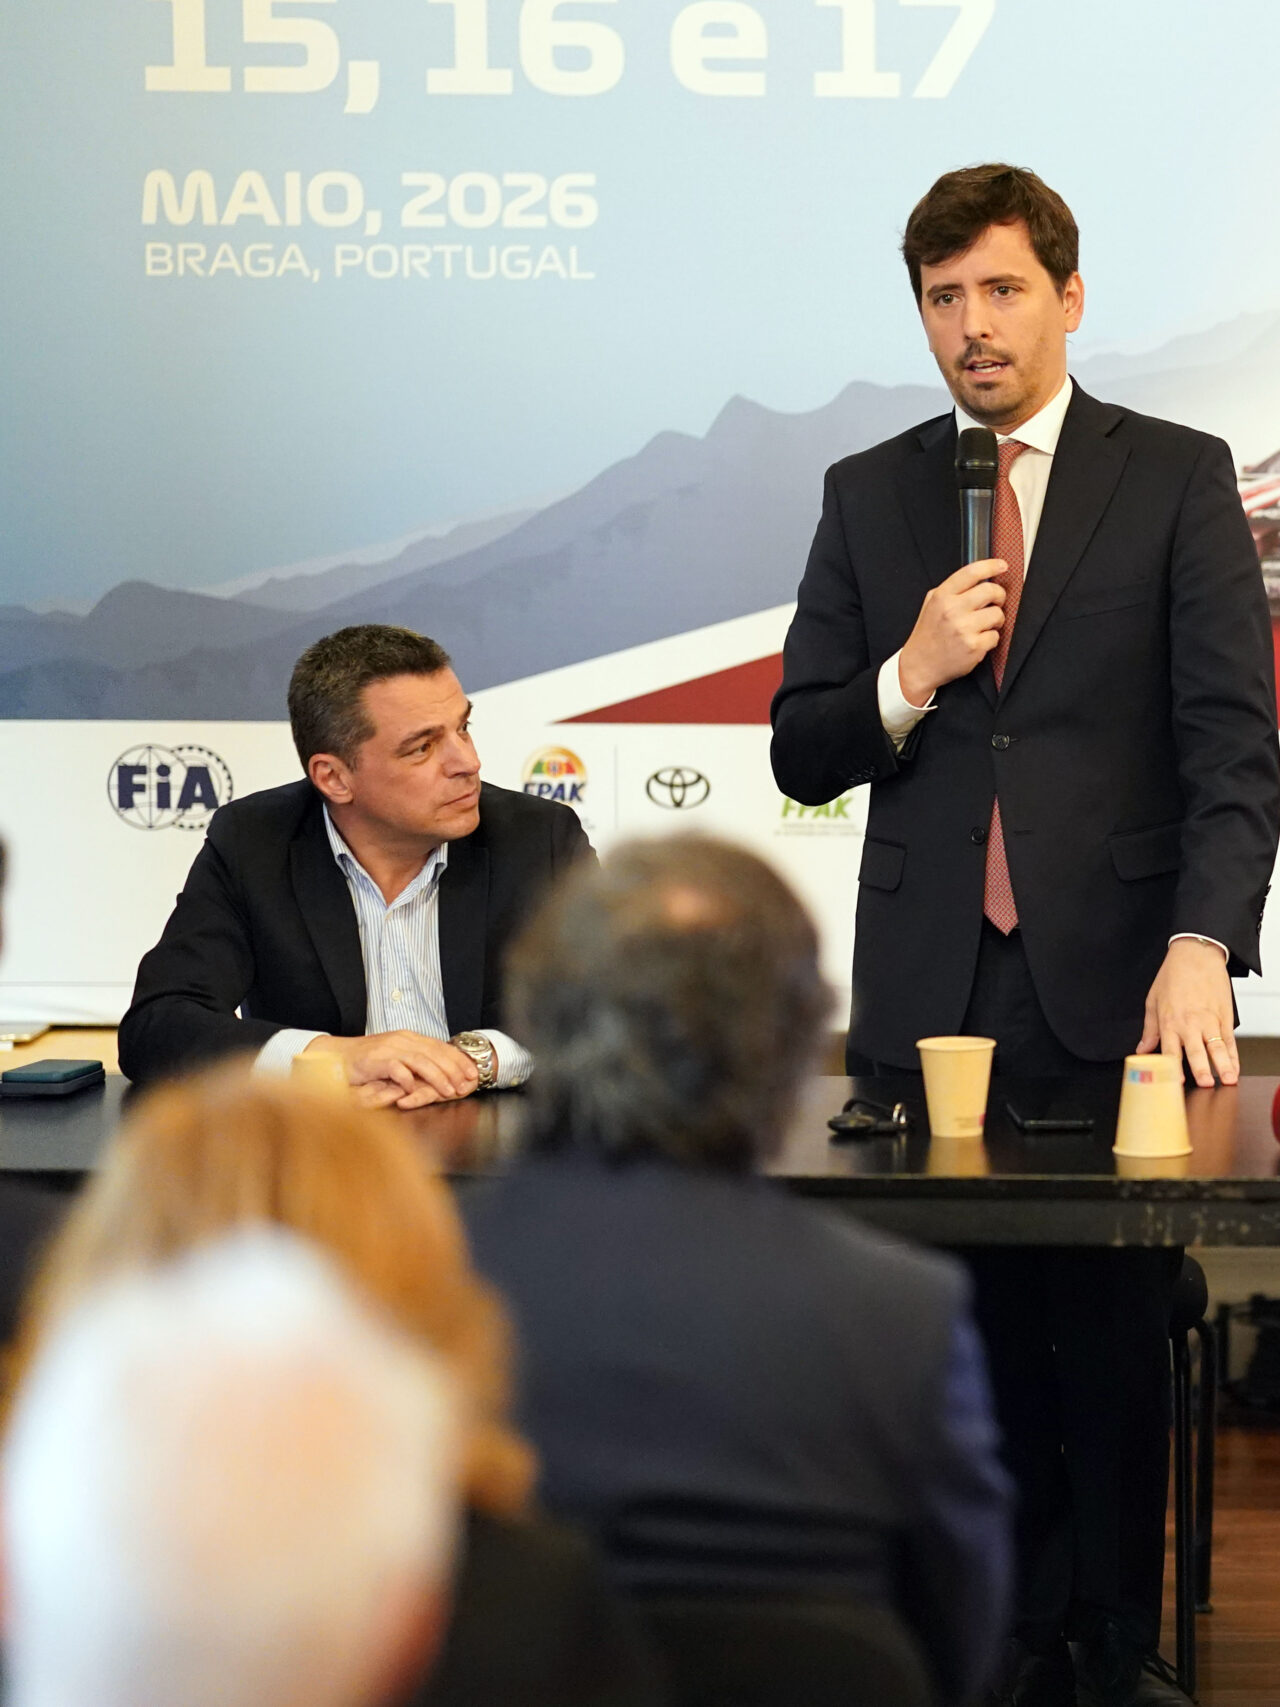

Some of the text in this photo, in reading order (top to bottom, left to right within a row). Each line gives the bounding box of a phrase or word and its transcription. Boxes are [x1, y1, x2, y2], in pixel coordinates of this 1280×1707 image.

[144, 0, 996, 115] 15, 16 e 17
[141, 168, 599, 236] MAIO, 2026
[144, 242, 596, 284] BRAGA, PORTUGAL
